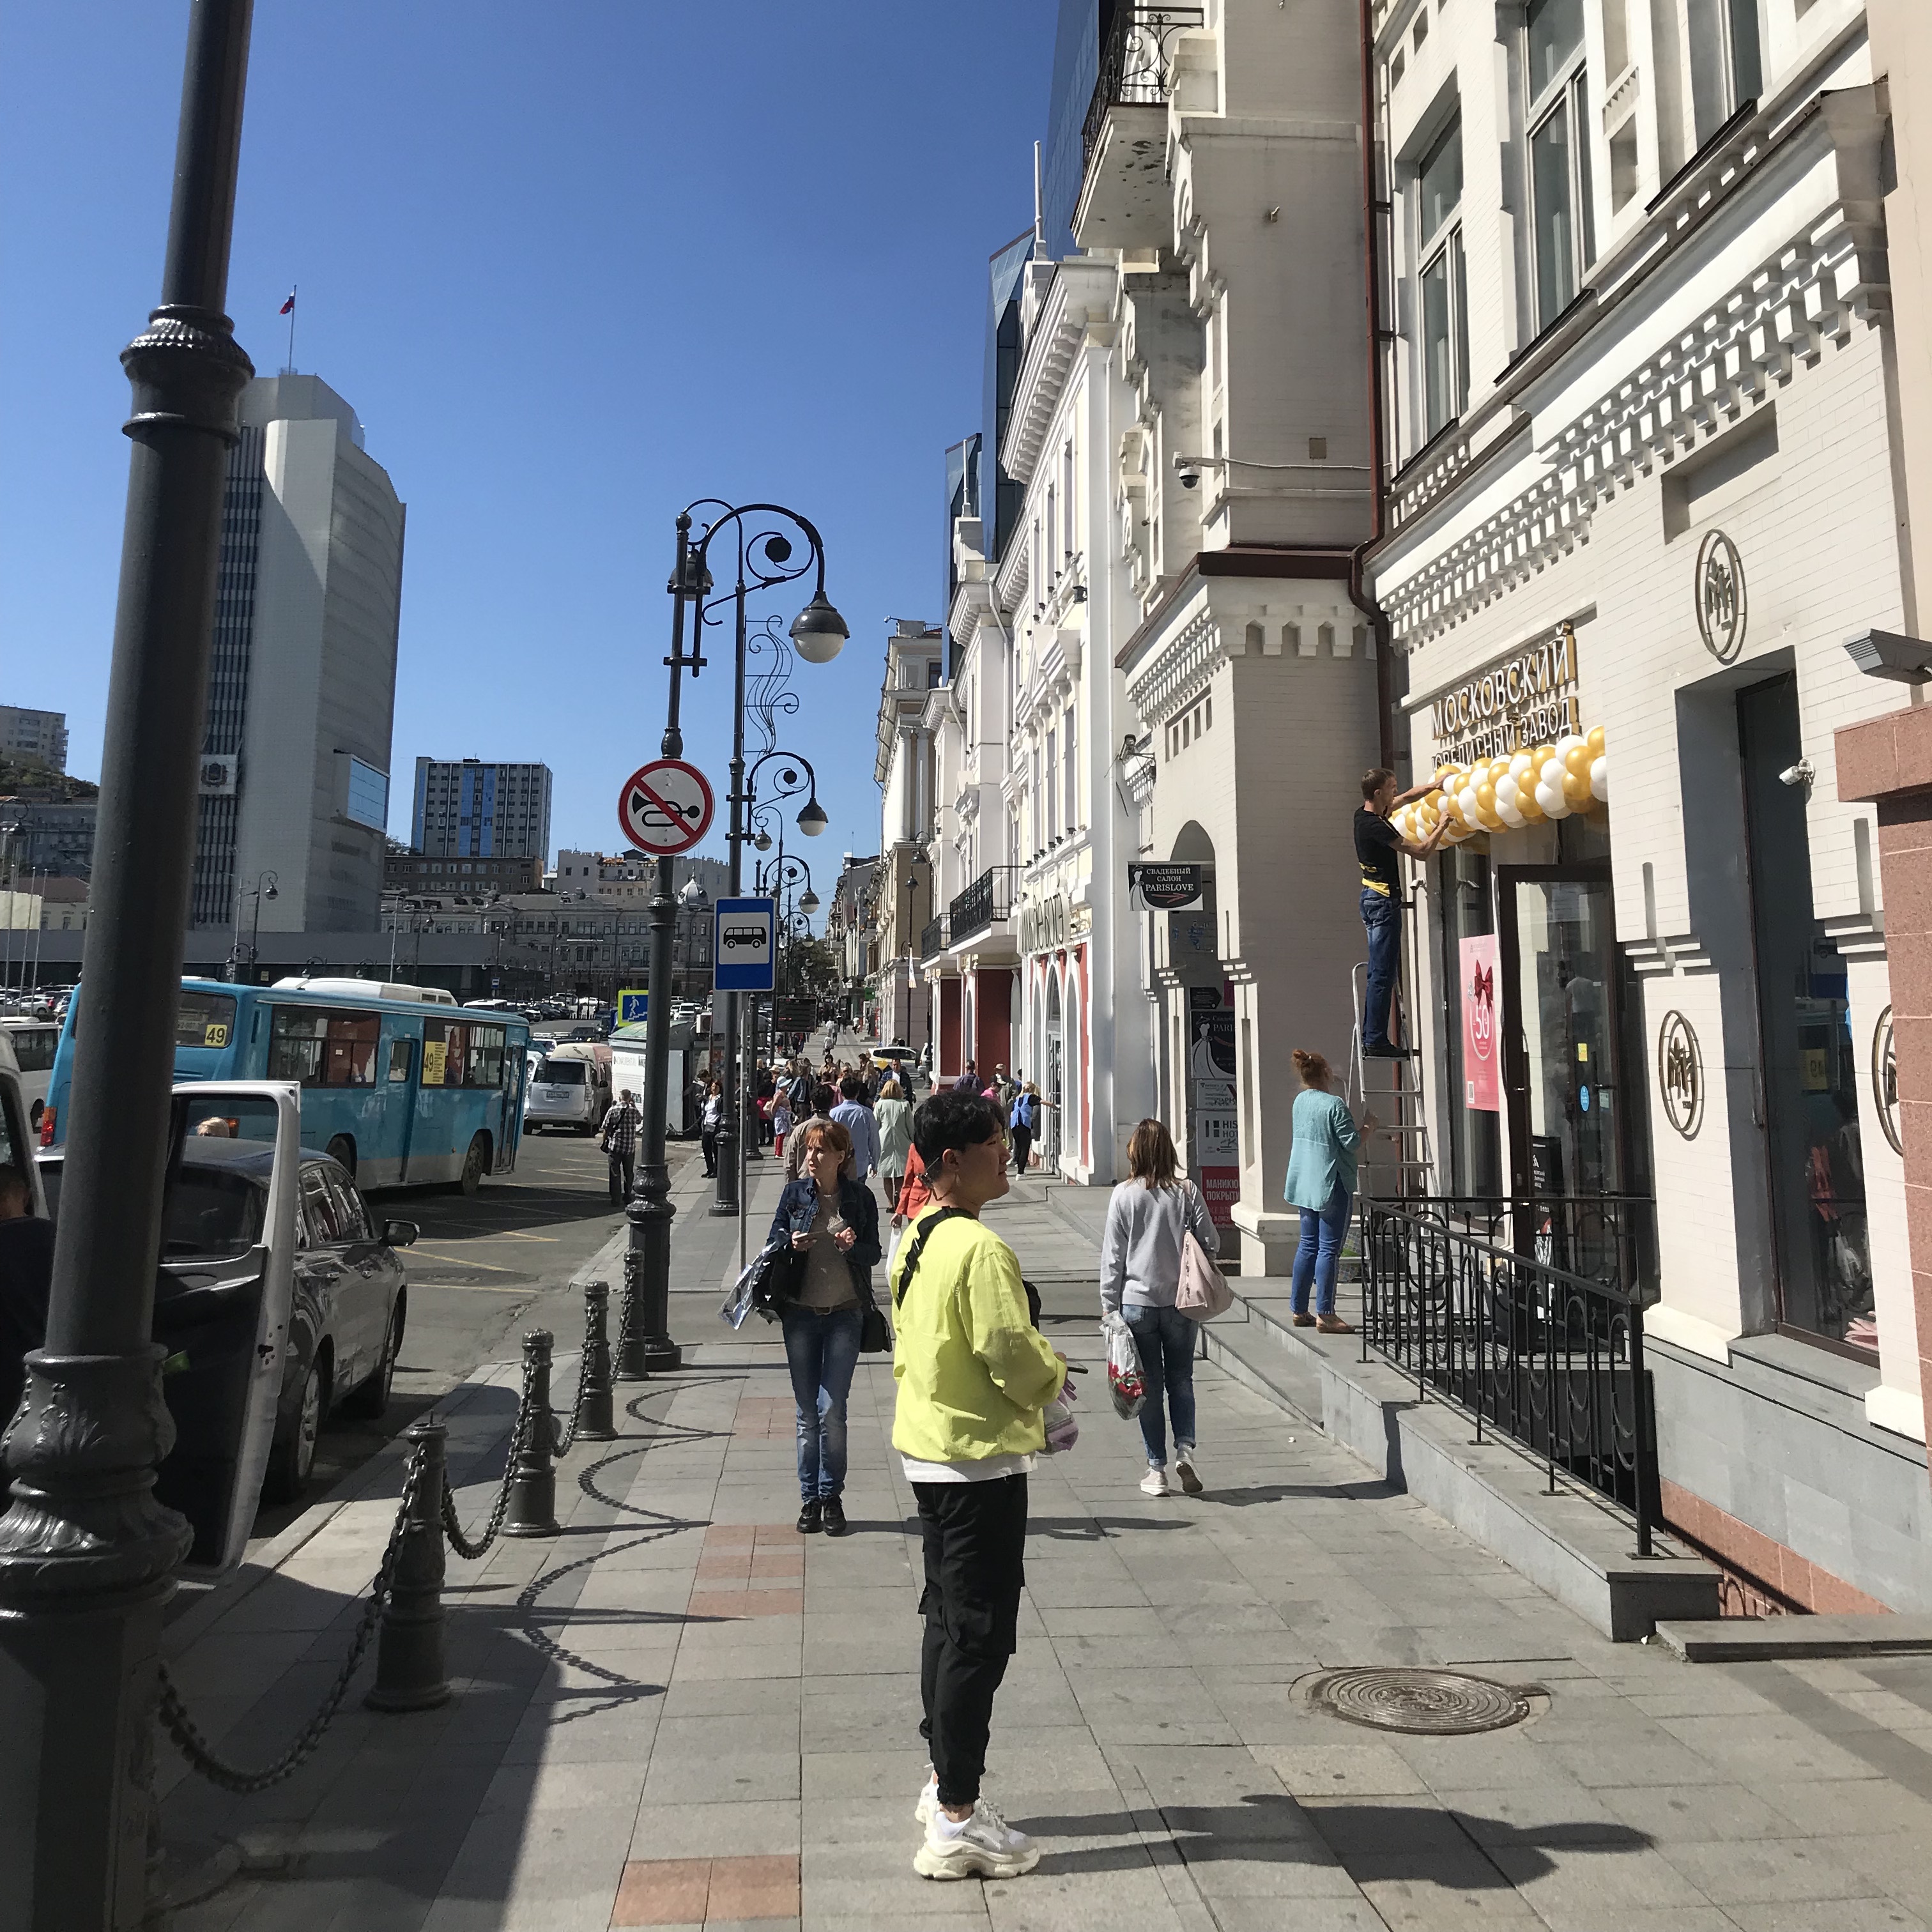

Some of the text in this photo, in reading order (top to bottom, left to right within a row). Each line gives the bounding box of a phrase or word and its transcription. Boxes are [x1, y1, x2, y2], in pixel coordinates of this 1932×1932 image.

[1431, 622, 1574, 739] МОСКОВСКИЙ
[1521, 697, 1574, 747] ЗАВОД
[1146, 883, 1194, 892] PARISLOVE
[206, 1027, 225, 1044] 49
[1213, 1023, 1234, 1032] PARI
[424, 1052, 434, 1073] 49
